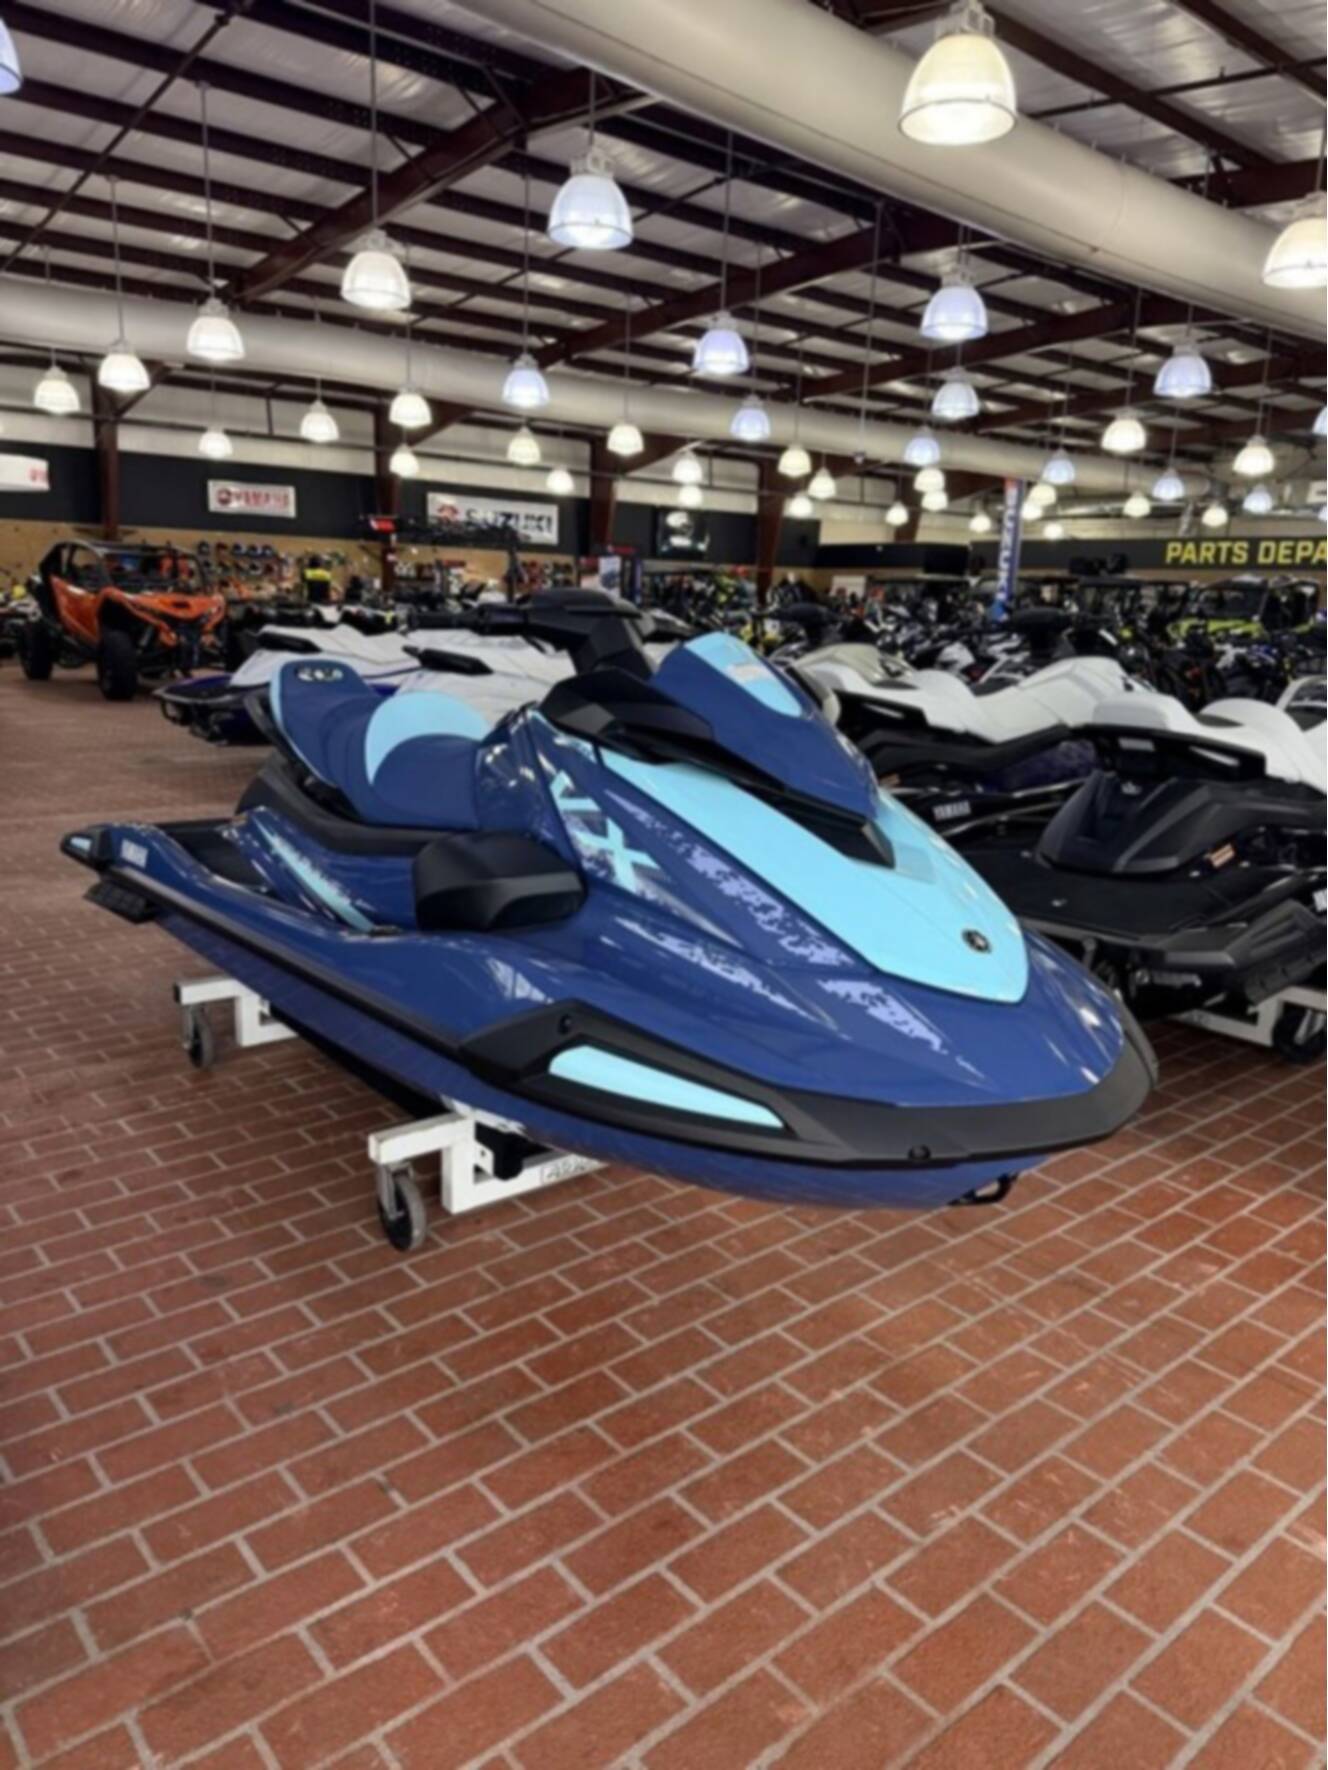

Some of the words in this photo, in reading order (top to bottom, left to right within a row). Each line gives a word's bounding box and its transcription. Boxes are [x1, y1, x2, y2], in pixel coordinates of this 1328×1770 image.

[464, 508, 554, 534] SUZUKI
[1165, 540, 1250, 565] PARTS
[1256, 540, 1328, 565] DEPA
